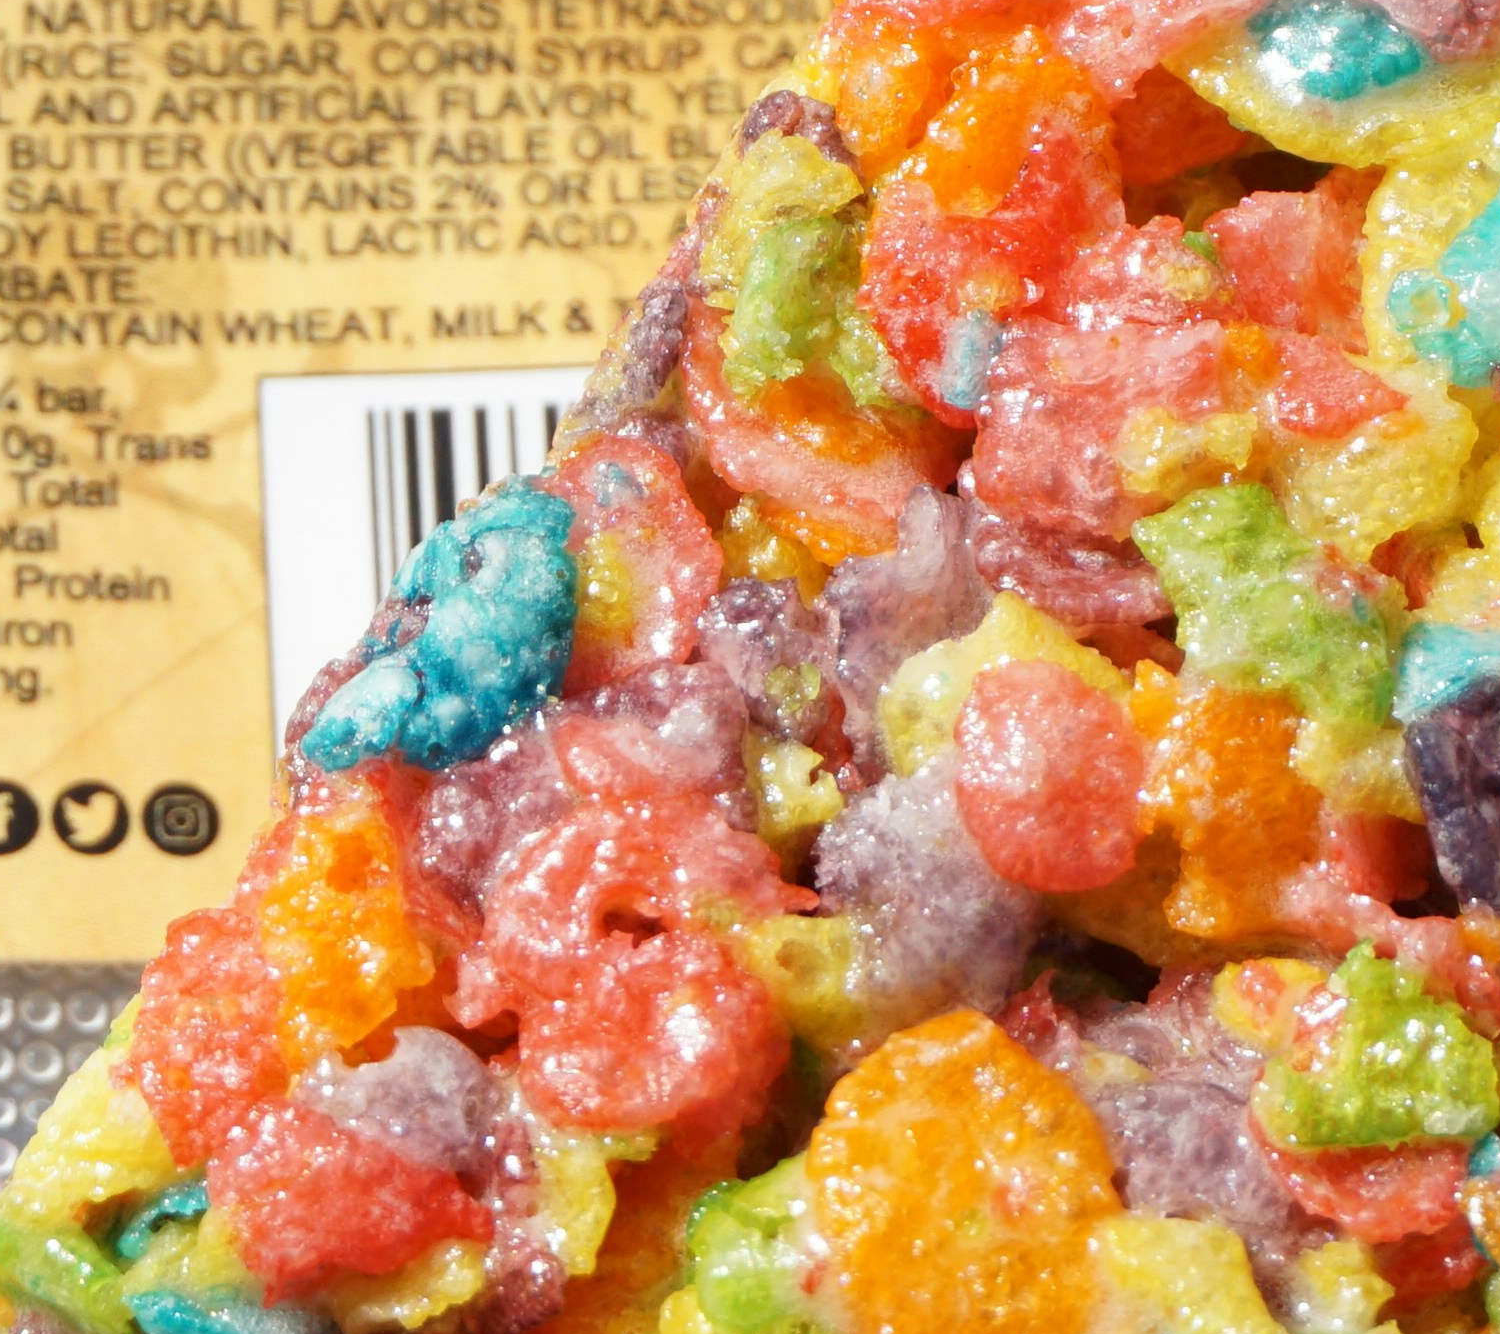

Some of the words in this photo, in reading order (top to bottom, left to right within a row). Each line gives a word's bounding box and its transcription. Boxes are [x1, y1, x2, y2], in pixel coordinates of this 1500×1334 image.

[370, 34, 516, 78] CORN
[30, 88, 137, 125] AND
[152, 83, 416, 124] ARTIFICIAL
[8, 130, 208, 171] BUTTER
[570, 122, 644, 164] OIL
[157, 174, 417, 216] CONTAINS
[520, 168, 590, 208] OR
[325, 216, 503, 258] LACTIC
[216, 304, 416, 348] WHEAT,
[431, 298, 550, 339] MILK
[564, 297, 593, 334] &
[34, 375, 122, 420] bar,
[87, 424, 215, 464] Trans
[10, 469, 122, 509] Total
[11, 562, 175, 604] Protein
